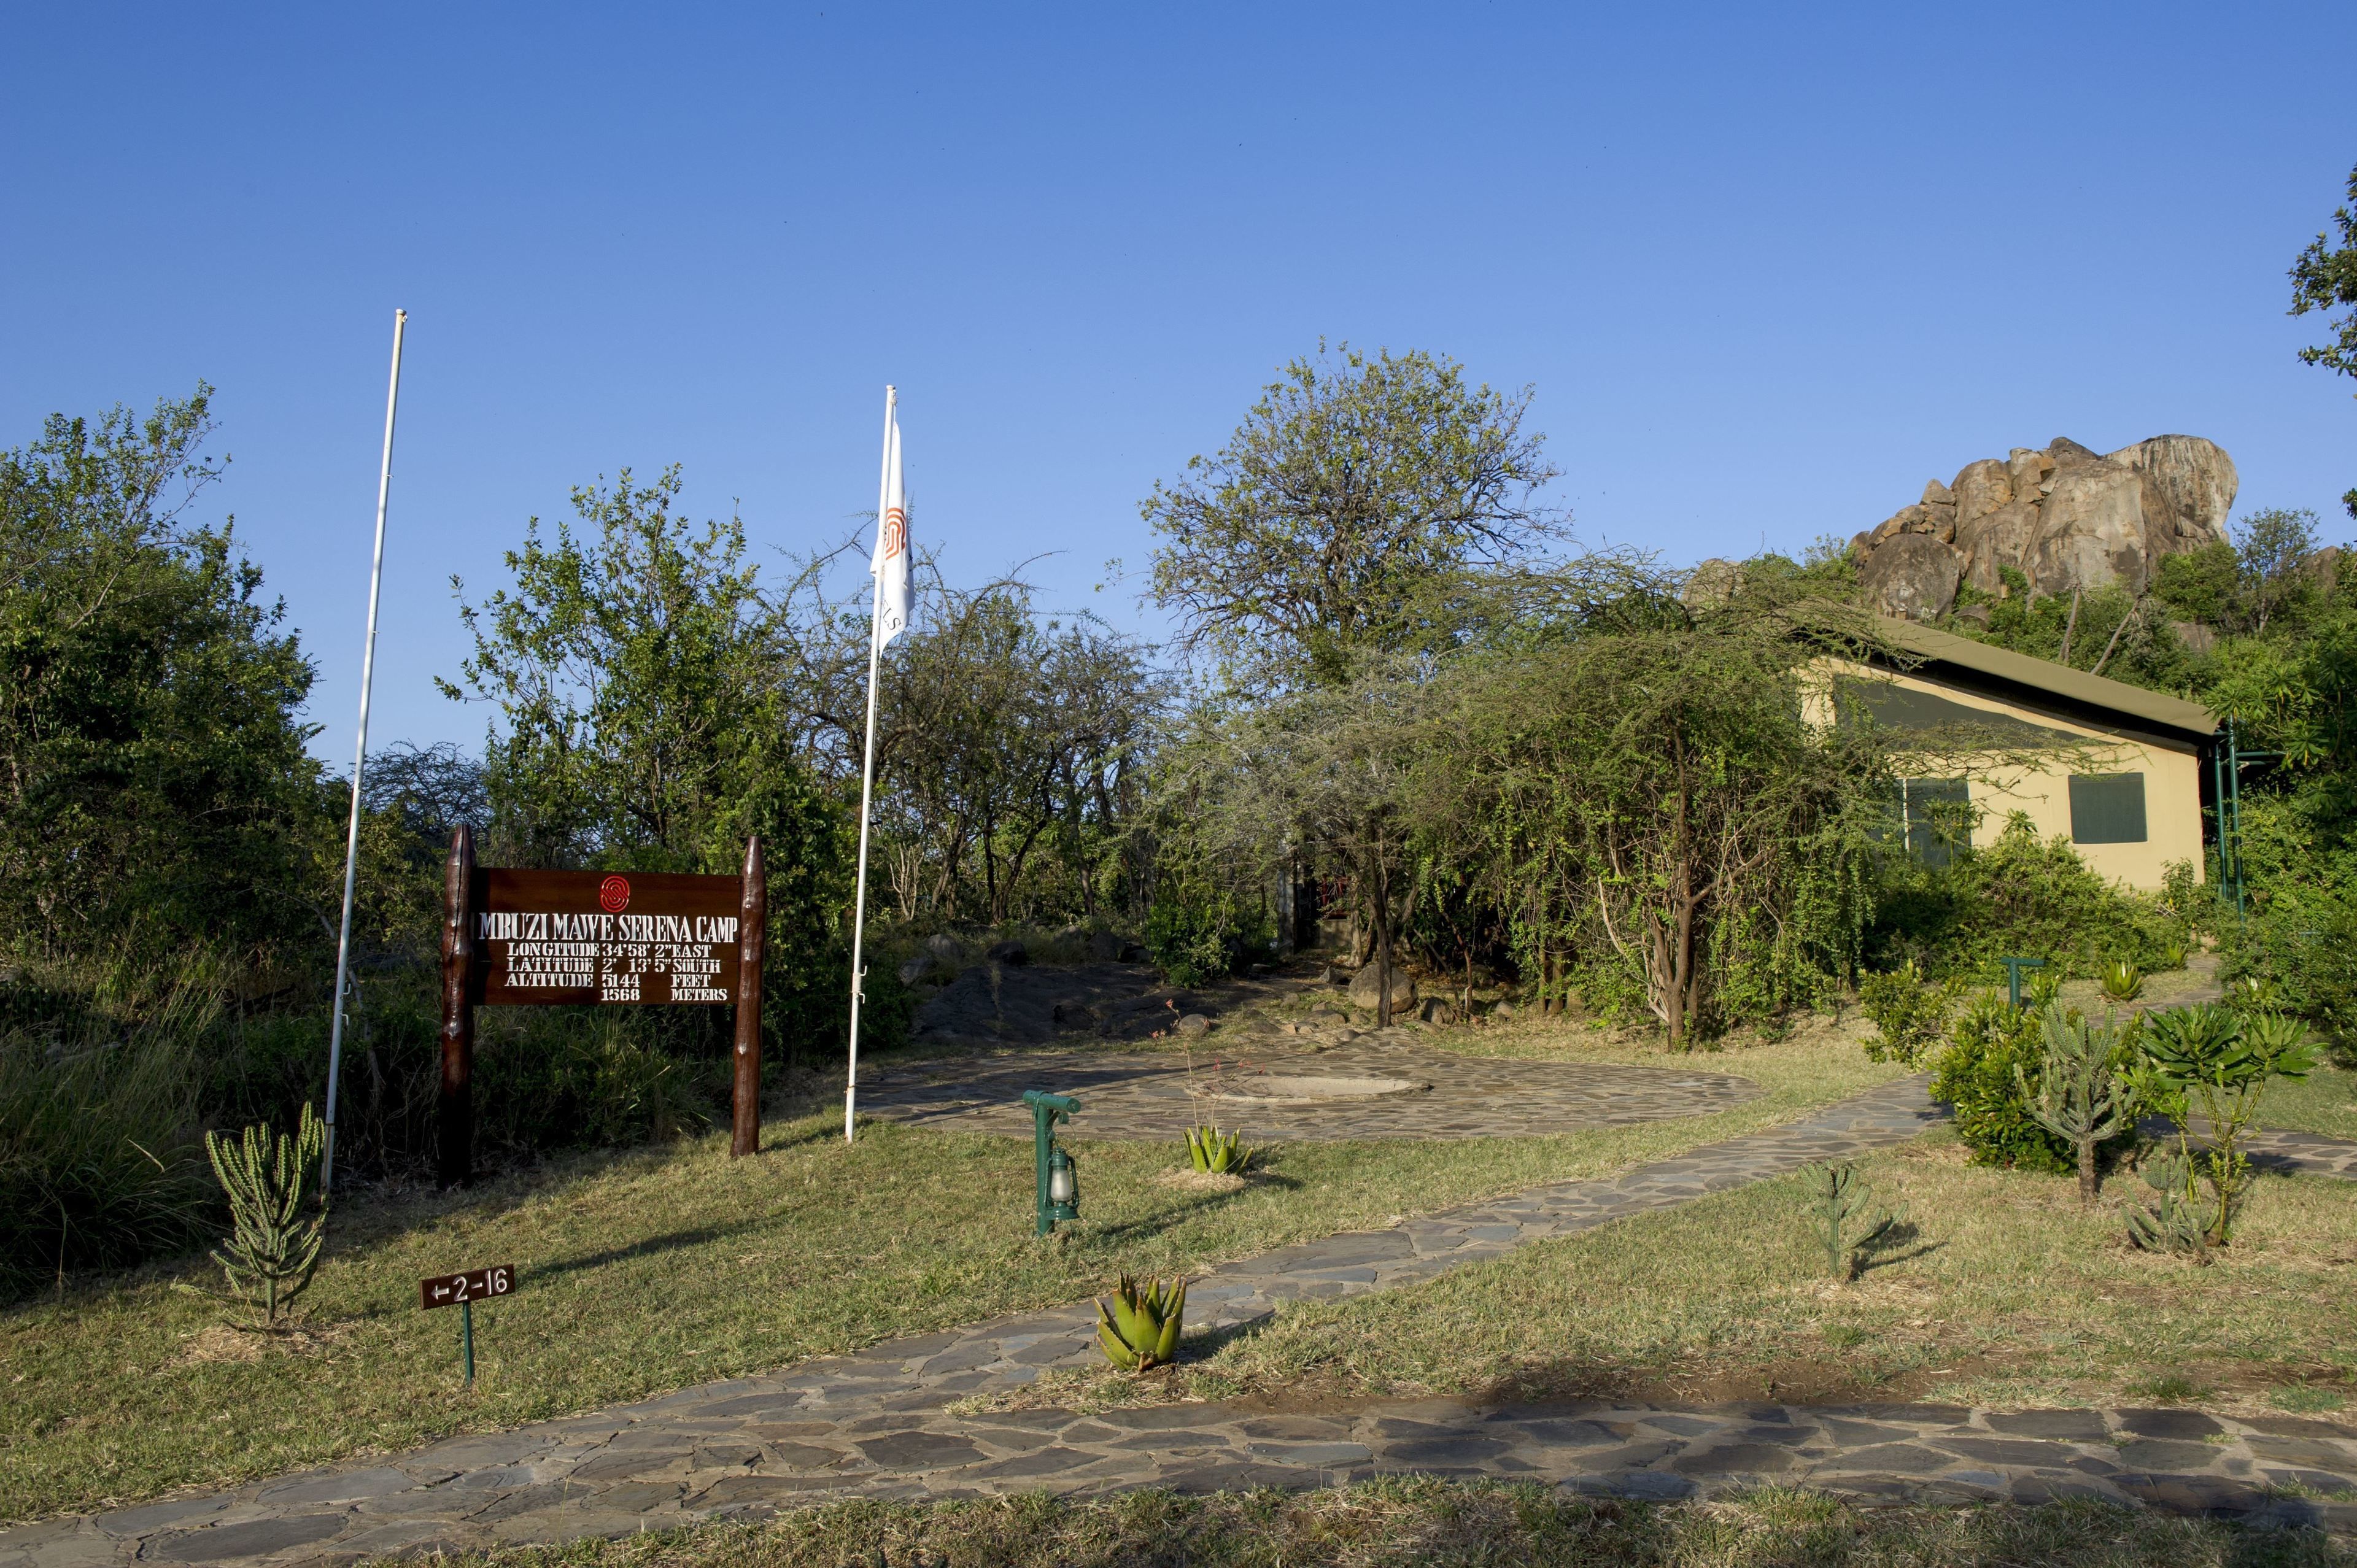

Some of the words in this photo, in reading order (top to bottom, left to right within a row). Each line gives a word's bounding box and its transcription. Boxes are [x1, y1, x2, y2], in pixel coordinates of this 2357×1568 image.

[479, 913, 548, 940] MBUZI
[552, 913, 613, 941] MAWE
[619, 914, 693, 942] SERENA
[696, 916, 738, 943] CAMP
[507, 942, 599, 957] LONGITUDE
[506, 957, 594, 973] LATITUDE
[673, 959, 721, 973] SOUTH
[504, 973, 593, 987] ALTITUDE
[602, 974, 640, 987] 5144
[671, 974, 711, 987] FEET
[601, 989, 640, 1001] 1568
[671, 989, 727, 1001] METERS
